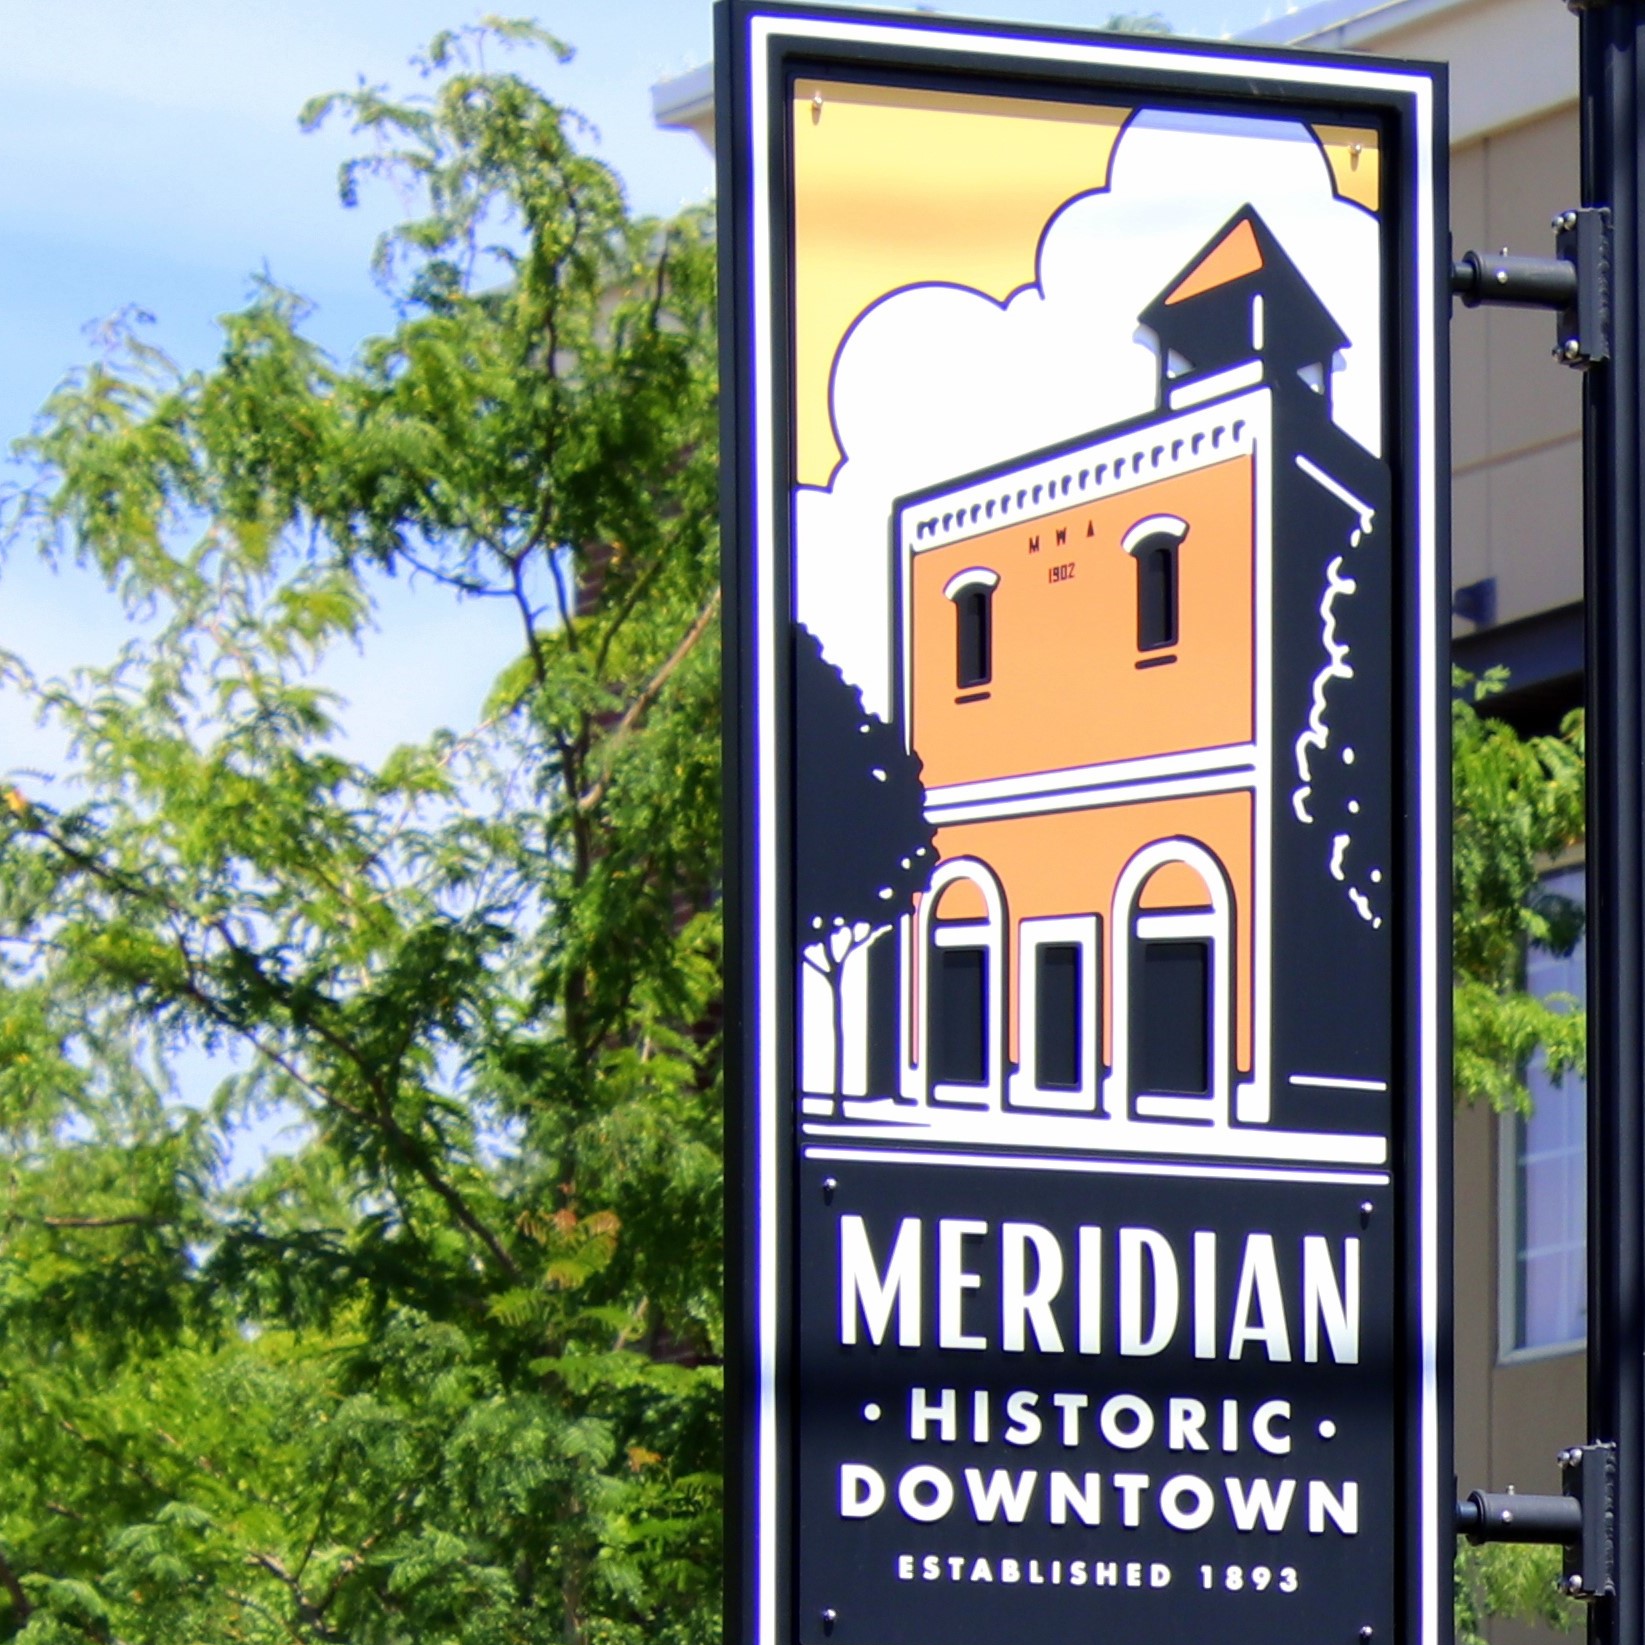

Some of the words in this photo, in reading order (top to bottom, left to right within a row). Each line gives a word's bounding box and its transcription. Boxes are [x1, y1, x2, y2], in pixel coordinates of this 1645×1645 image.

[1048, 562, 1075, 583] 1902
[840, 1214, 1360, 1364] MERIDIAN
[910, 1388, 1291, 1455] HISTORIC
[841, 1463, 1358, 1534] DOWNTOWN
[898, 1554, 1171, 1588] ESTABLISHED
[1200, 1564, 1298, 1593] 1893
